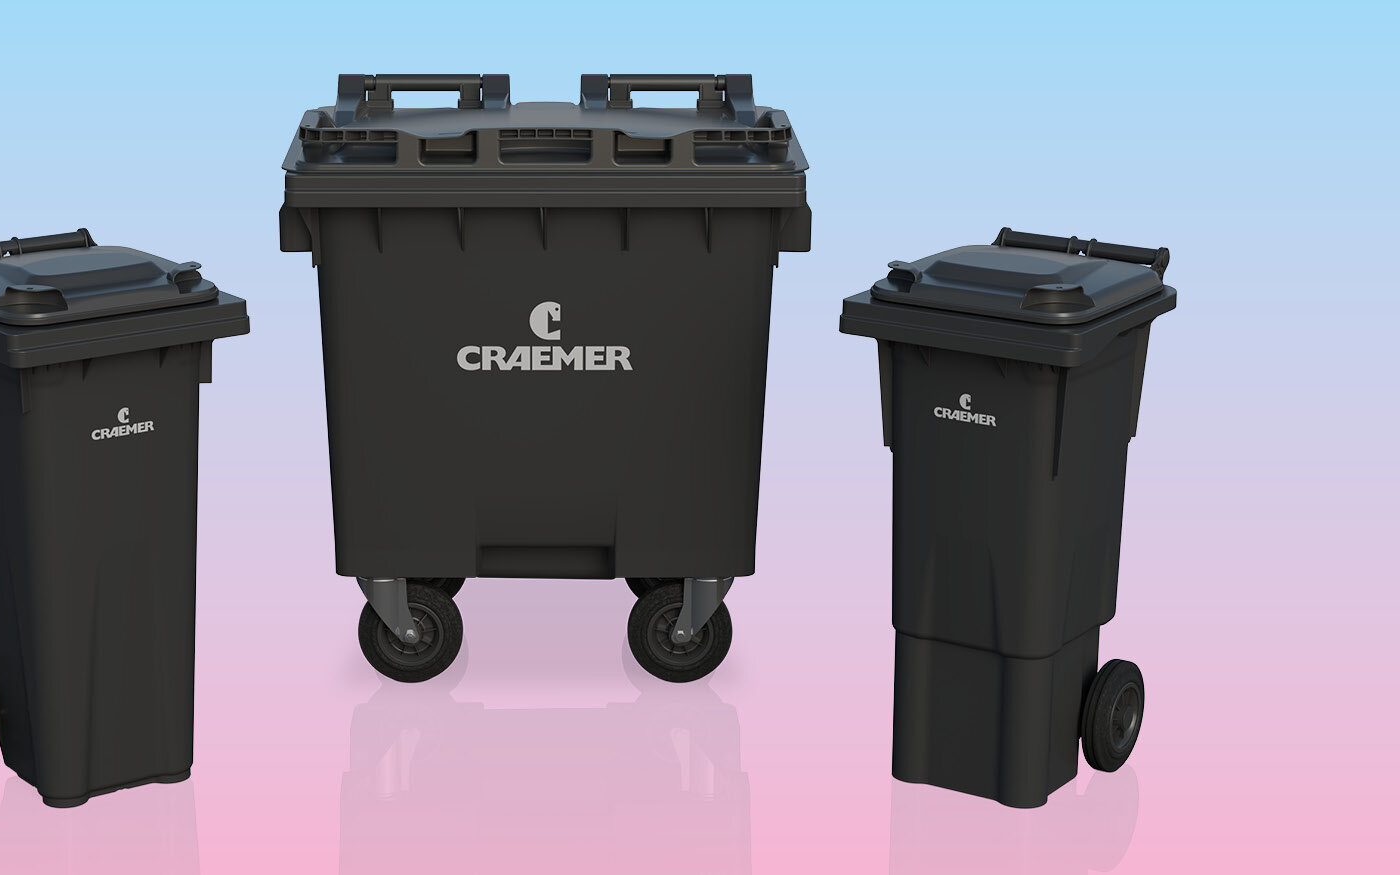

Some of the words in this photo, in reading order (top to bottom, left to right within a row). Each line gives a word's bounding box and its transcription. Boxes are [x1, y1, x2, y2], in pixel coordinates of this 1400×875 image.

[457, 346, 633, 370] CRAEMER
[934, 407, 997, 426] CRAEMER
[91, 421, 154, 440] CRAEMER
